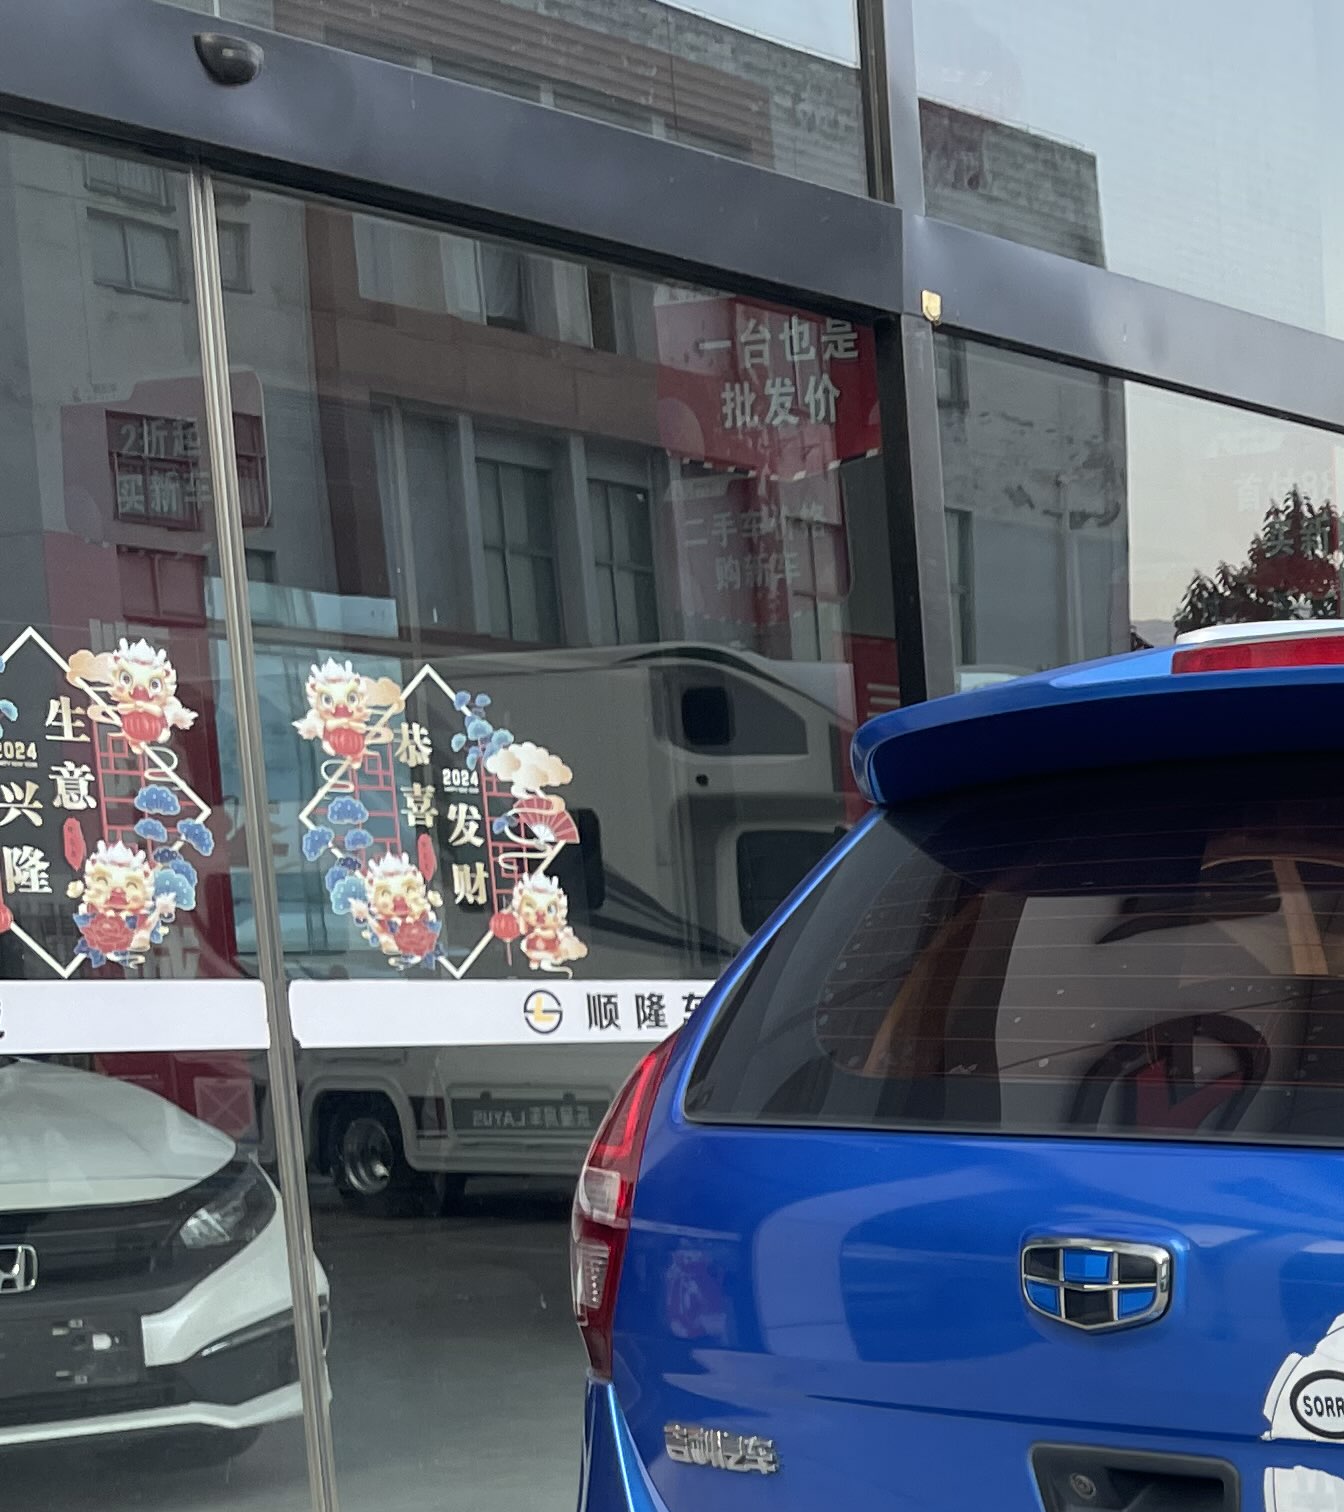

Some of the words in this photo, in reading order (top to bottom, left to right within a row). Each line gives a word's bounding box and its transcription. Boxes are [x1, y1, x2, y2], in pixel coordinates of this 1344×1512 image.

[699, 314, 859, 369] 一台也是
[720, 375, 841, 428] 批发价
[0, 741, 38, 761] 024
[45, 696, 97, 810] 生意
[395, 722, 439, 828] 恭喜
[442, 768, 479, 787] 2024
[0, 780, 52, 893] 兴隆
[447, 803, 489, 905] 发财
